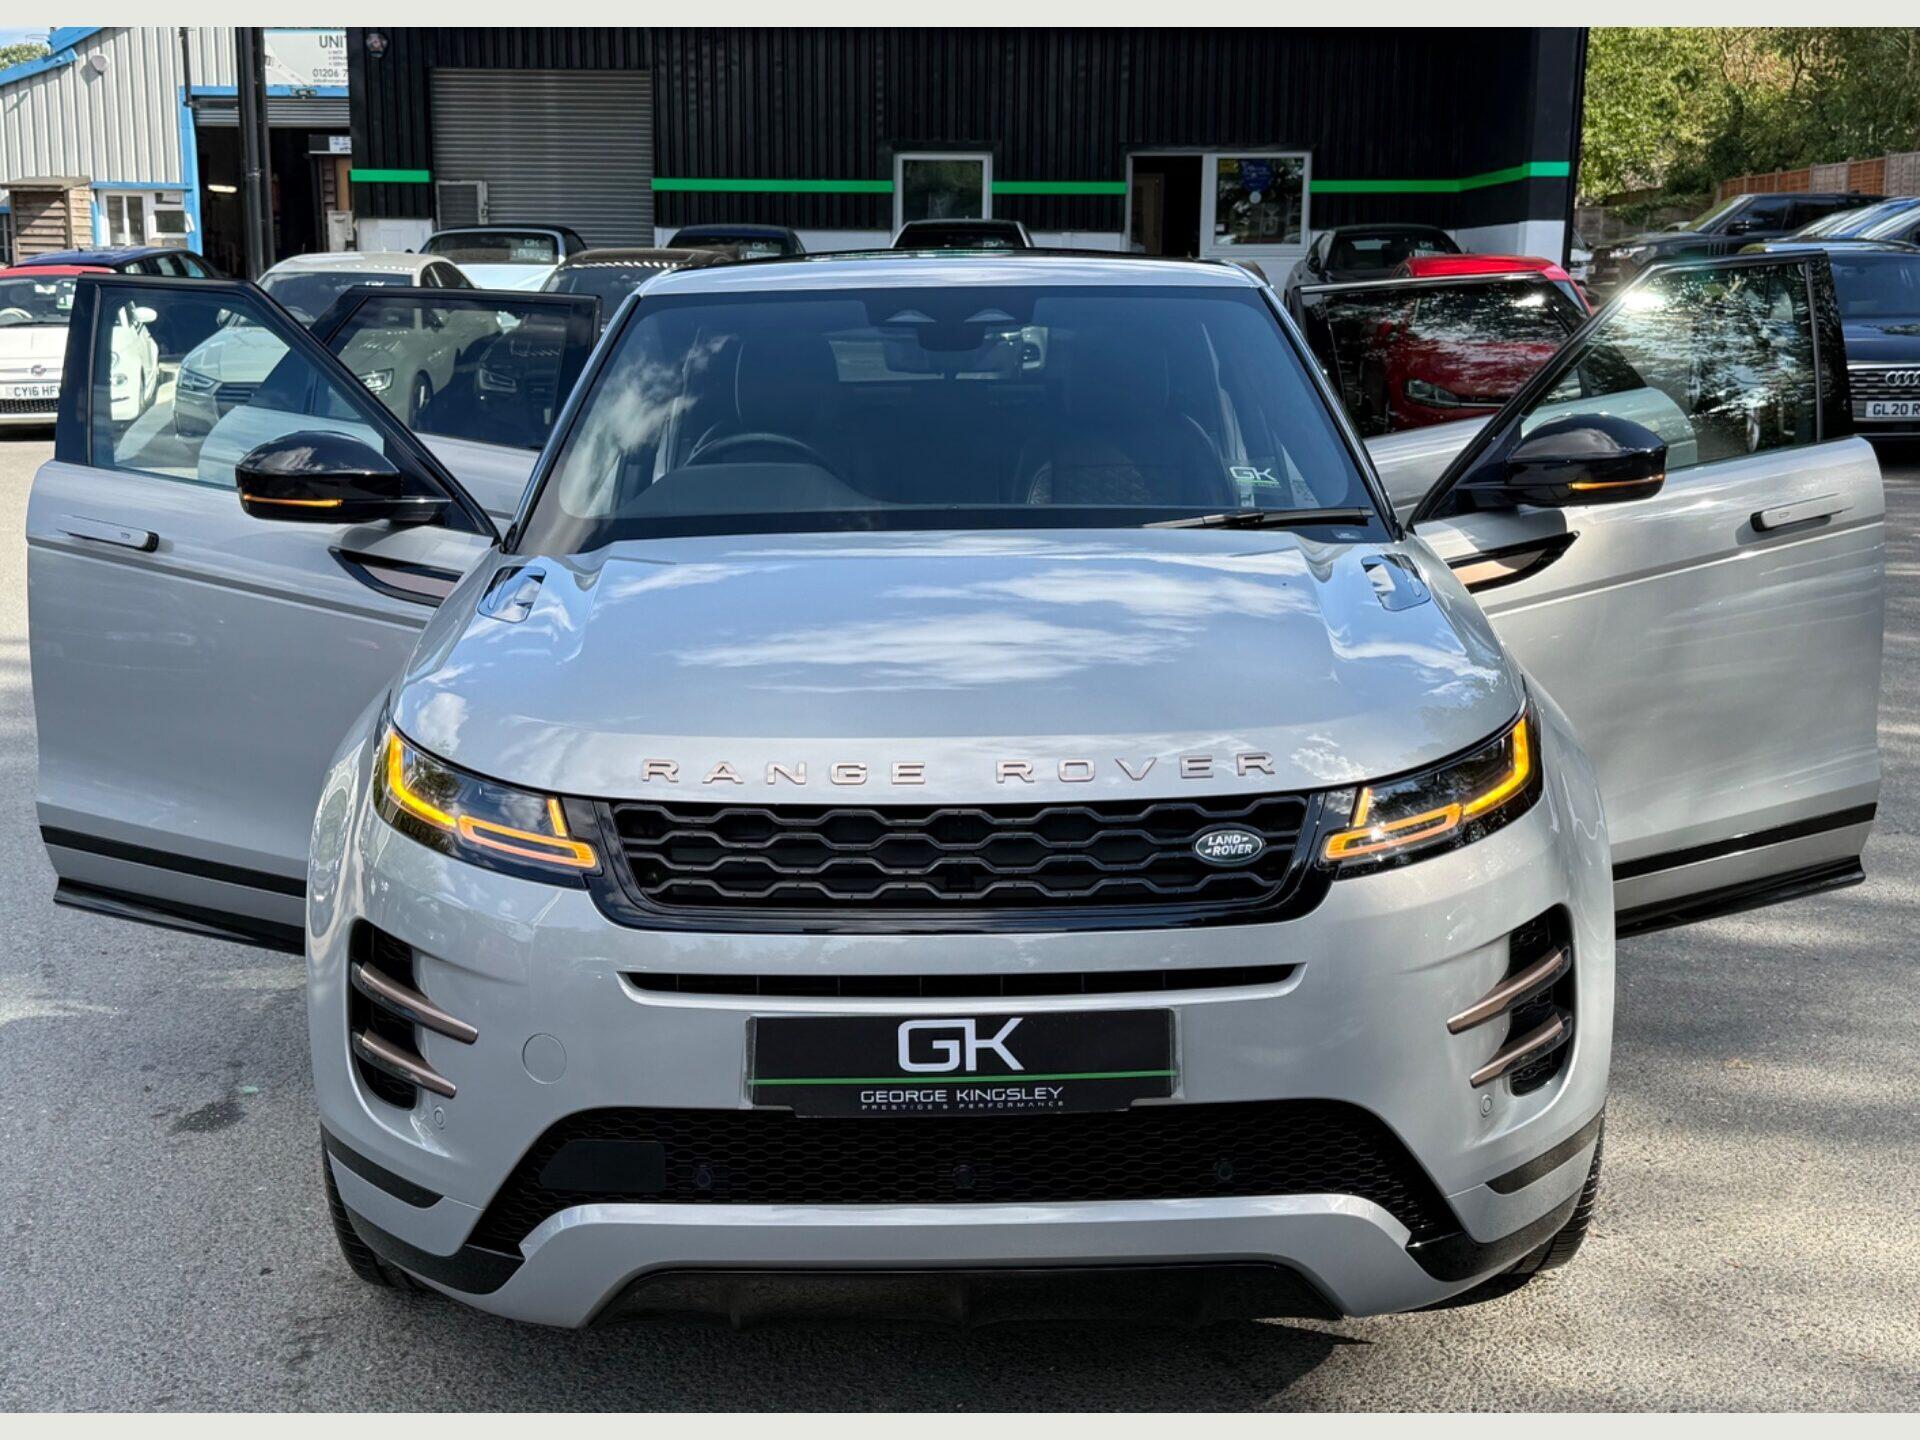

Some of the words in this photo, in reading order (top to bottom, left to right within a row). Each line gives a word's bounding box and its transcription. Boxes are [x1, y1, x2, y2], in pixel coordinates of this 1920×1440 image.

[312, 68, 339, 78] 01206
[14, 386, 39, 396] CY16
[1873, 403, 1909, 415] GL20
[1229, 466, 1278, 481] GK
[642, 758, 926, 785] RANGE
[996, 752, 1275, 783] ROVER
[898, 1017, 1025, 1072] GK
[861, 1090, 947, 1103] GEORGE
[956, 1087, 1064, 1100] KINGSLEY
[959, 1101, 1064, 1109] PERFORMANCE
